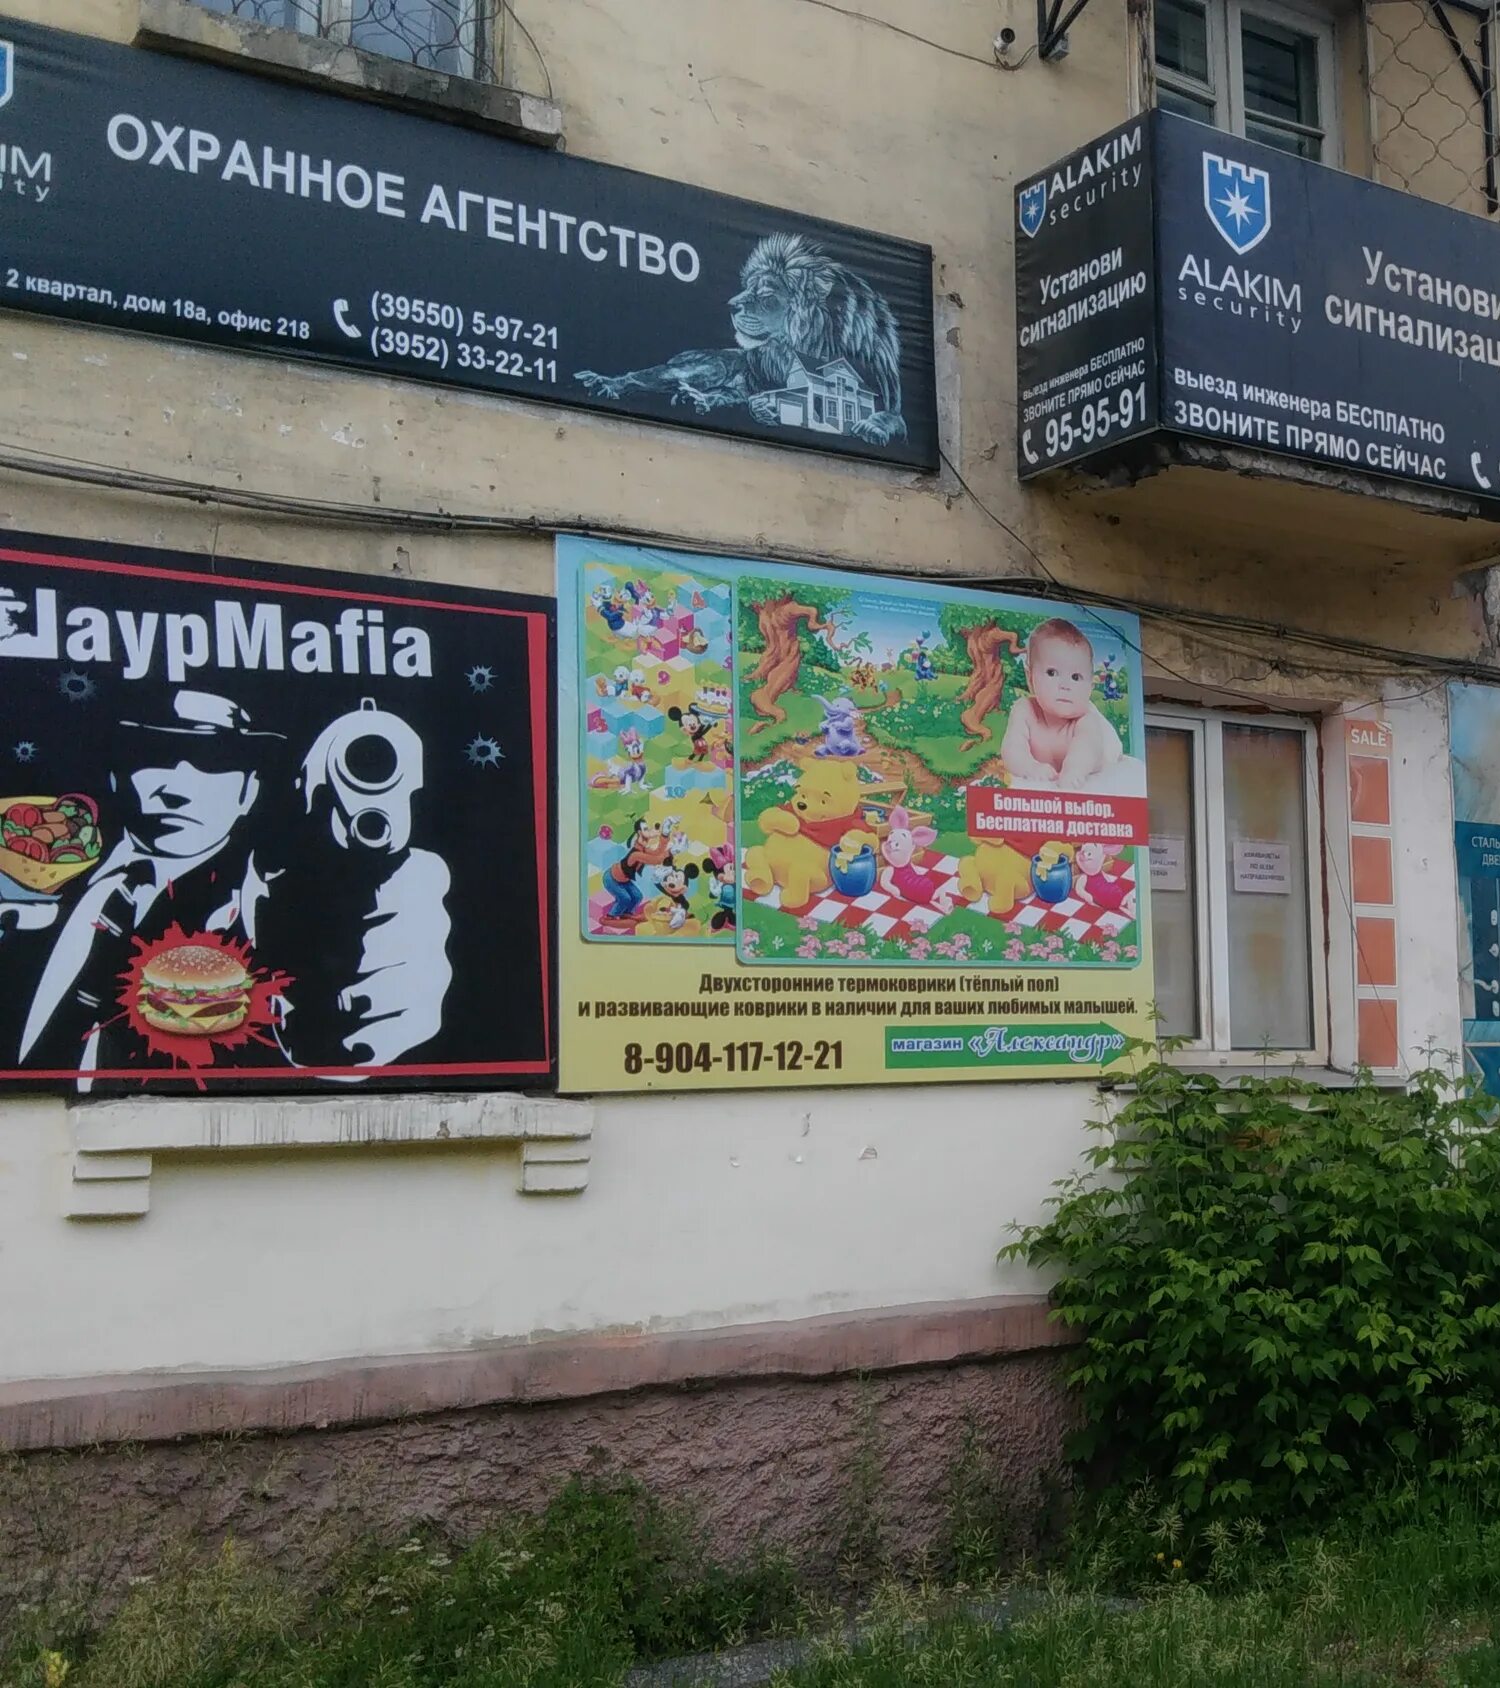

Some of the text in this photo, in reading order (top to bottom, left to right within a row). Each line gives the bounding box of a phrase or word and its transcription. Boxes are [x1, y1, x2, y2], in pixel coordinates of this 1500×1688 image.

[1049, 126, 1141, 200] ALAKIM
[107, 114, 699, 282] ОХРАННОЕ АГЕНТСТВО
[1050, 163, 1142, 225] security
[7, 269, 309, 339] 2 квартал, дом 18а, офис 218
[1040, 247, 1122, 305] Установи
[1178, 254, 1301, 312] ALAKIM
[372, 291, 557, 349] (39550) 5-97-21
[1020, 272, 1146, 347] сигнализацию
[1178, 287, 1301, 333] security
[371, 327, 556, 383] (3952) 33-22-11
[1023, 337, 1145, 400] выезд инженера БЕСПЛАТНО
[1023, 360, 1145, 423] ЗВОНИТЕ ПРЯМО СЕЙЧАС
[1046, 381, 1146, 457] 95-95-91
[1174, 367, 1445, 444] выезд инженера БЕСПЛАТНО
[1174, 400, 1446, 480] ЗВОНИТЕ ПРЯМО СЕЙЧАС
[1351, 729, 1387, 747] SALE
[976, 813, 1133, 838] Бесплатная доставка
[994, 794, 1115, 818] Большой выбор.
[578, 998, 1138, 1019] и развивающие коврики в наличии для ваших любимых малышей.
[699, 974, 1059, 994] Двухсторонние термоковрики (тёплый пол)
[624, 1040, 842, 1074] 8-904-117-12-21
[892, 1026, 1126, 1063] магазин «Александр»
